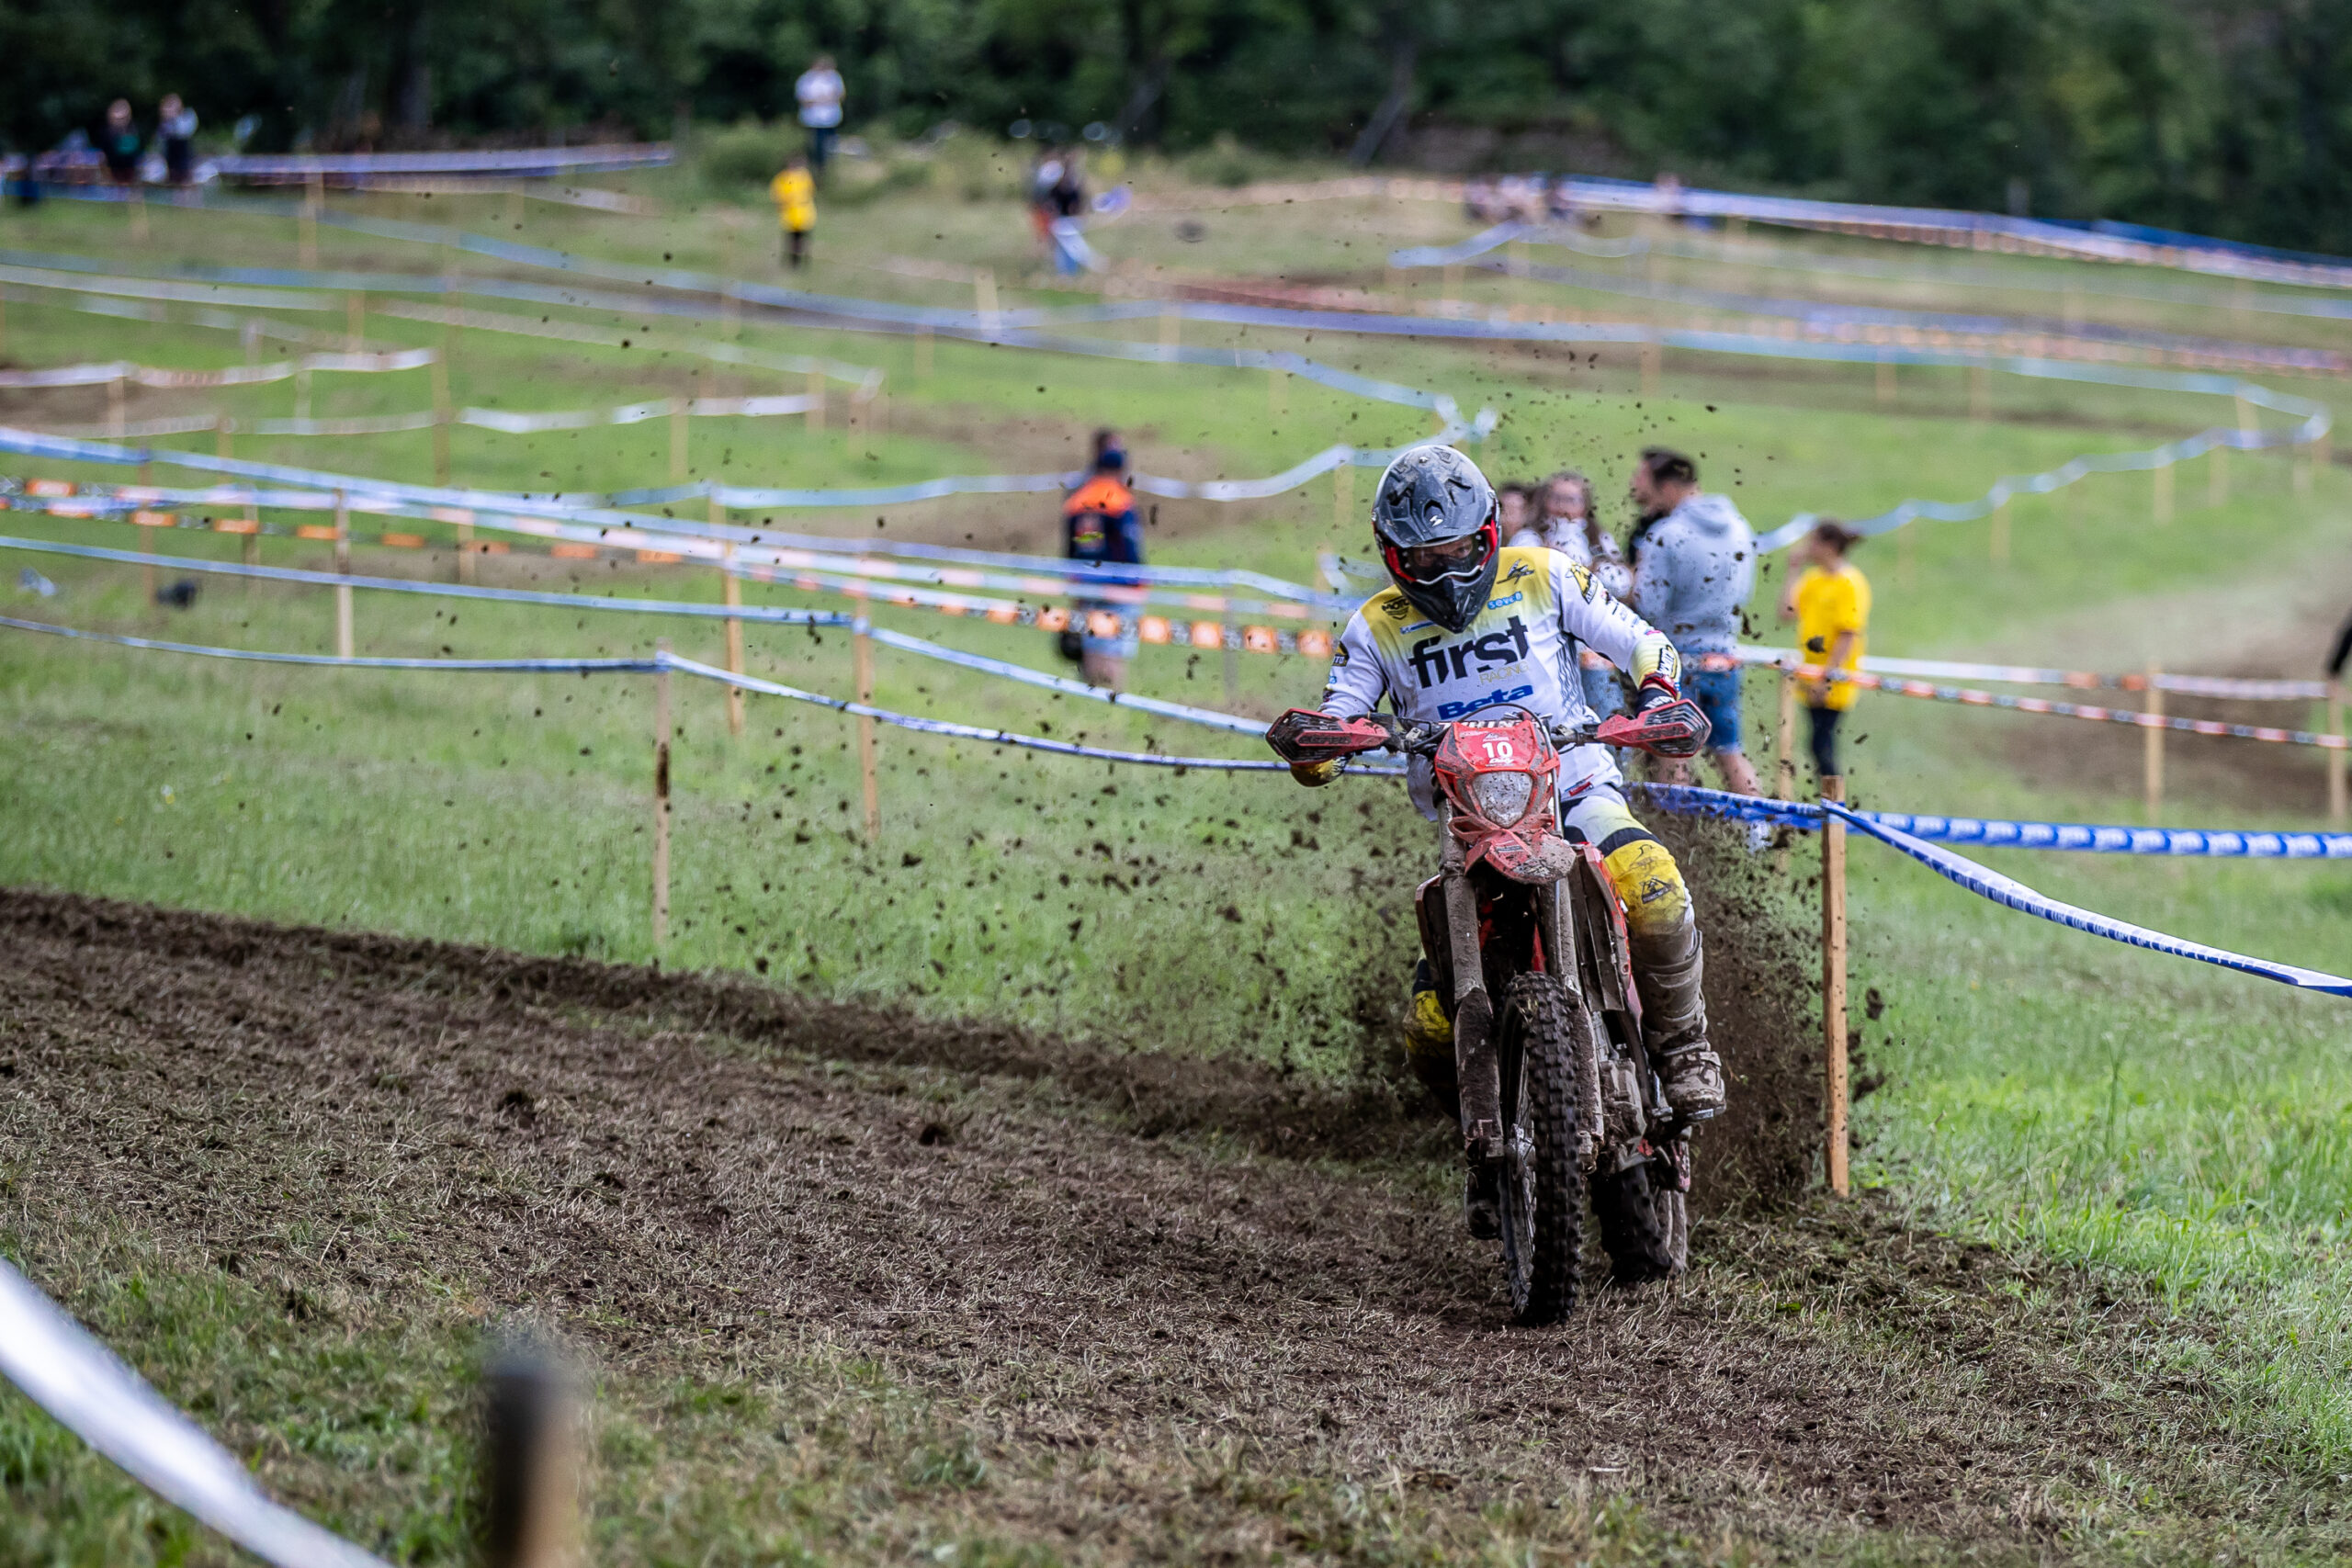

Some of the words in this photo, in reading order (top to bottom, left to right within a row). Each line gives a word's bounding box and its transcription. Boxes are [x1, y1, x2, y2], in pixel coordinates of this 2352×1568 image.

[1408, 615, 1529, 689] first
[1479, 661, 1530, 685] RACING
[1437, 684, 1533, 720] Beta
[1482, 741, 1514, 759] 10
